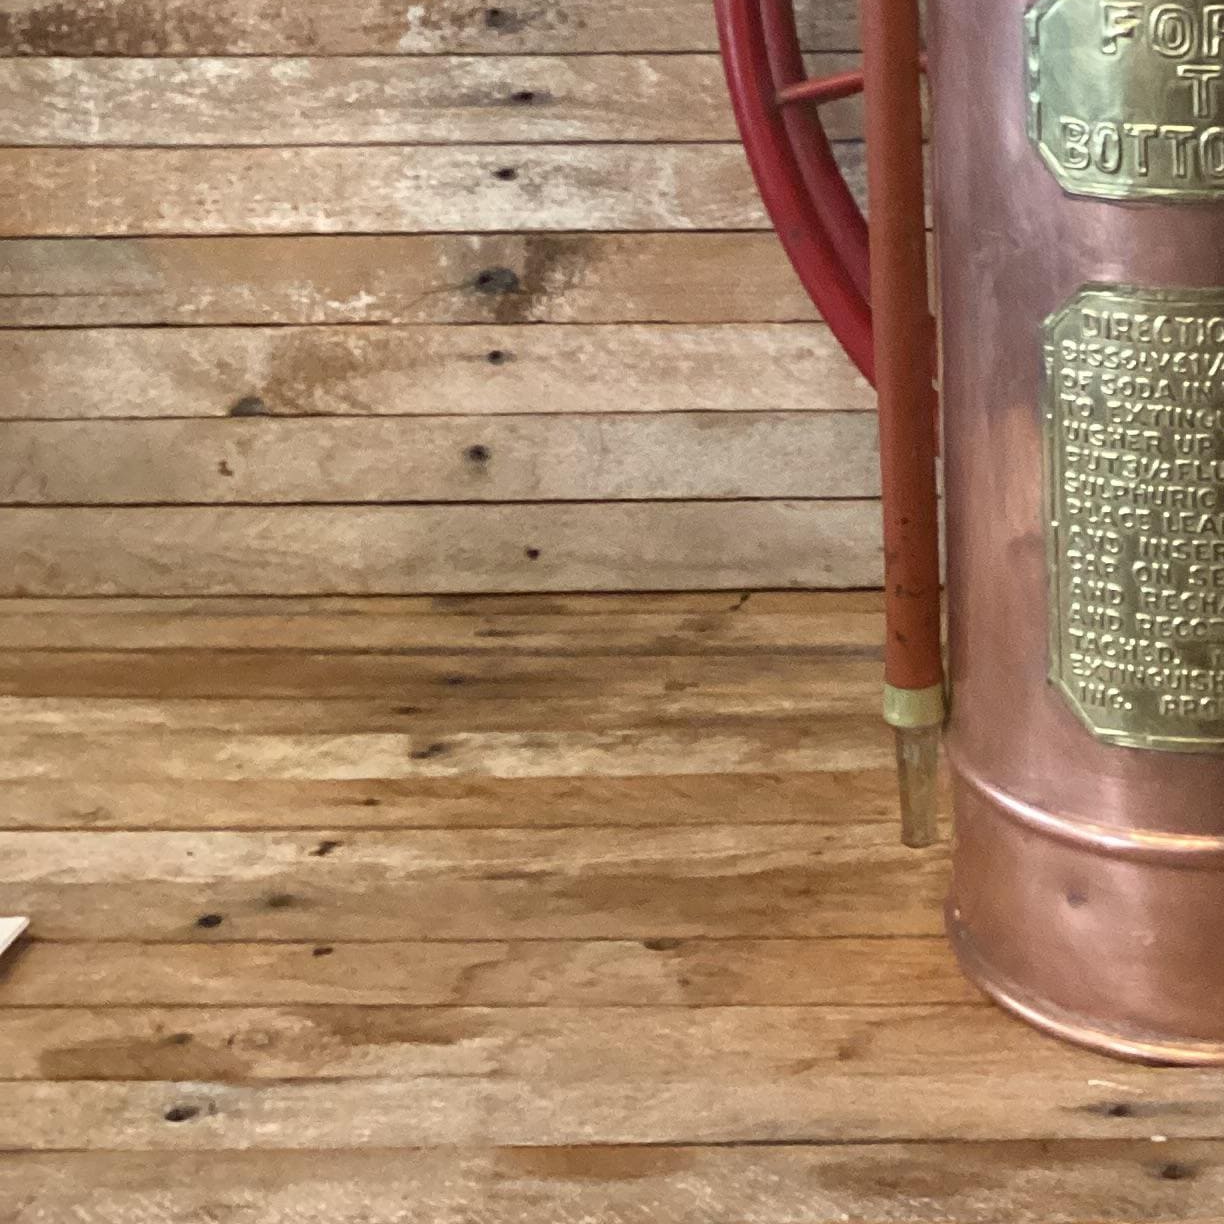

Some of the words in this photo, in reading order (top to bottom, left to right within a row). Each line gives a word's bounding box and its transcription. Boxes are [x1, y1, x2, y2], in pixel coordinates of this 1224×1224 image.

[1060, 367, 1094, 392] OF
[1100, 372, 1177, 402] SODA
[1182, 380, 1213, 402] IN
[1059, 392, 1095, 419] TO
[1174, 433, 1215, 456] UP
[1131, 559, 1174, 585] ON
[1068, 576, 1124, 606] AND
[1067, 602, 1124, 631] AND
